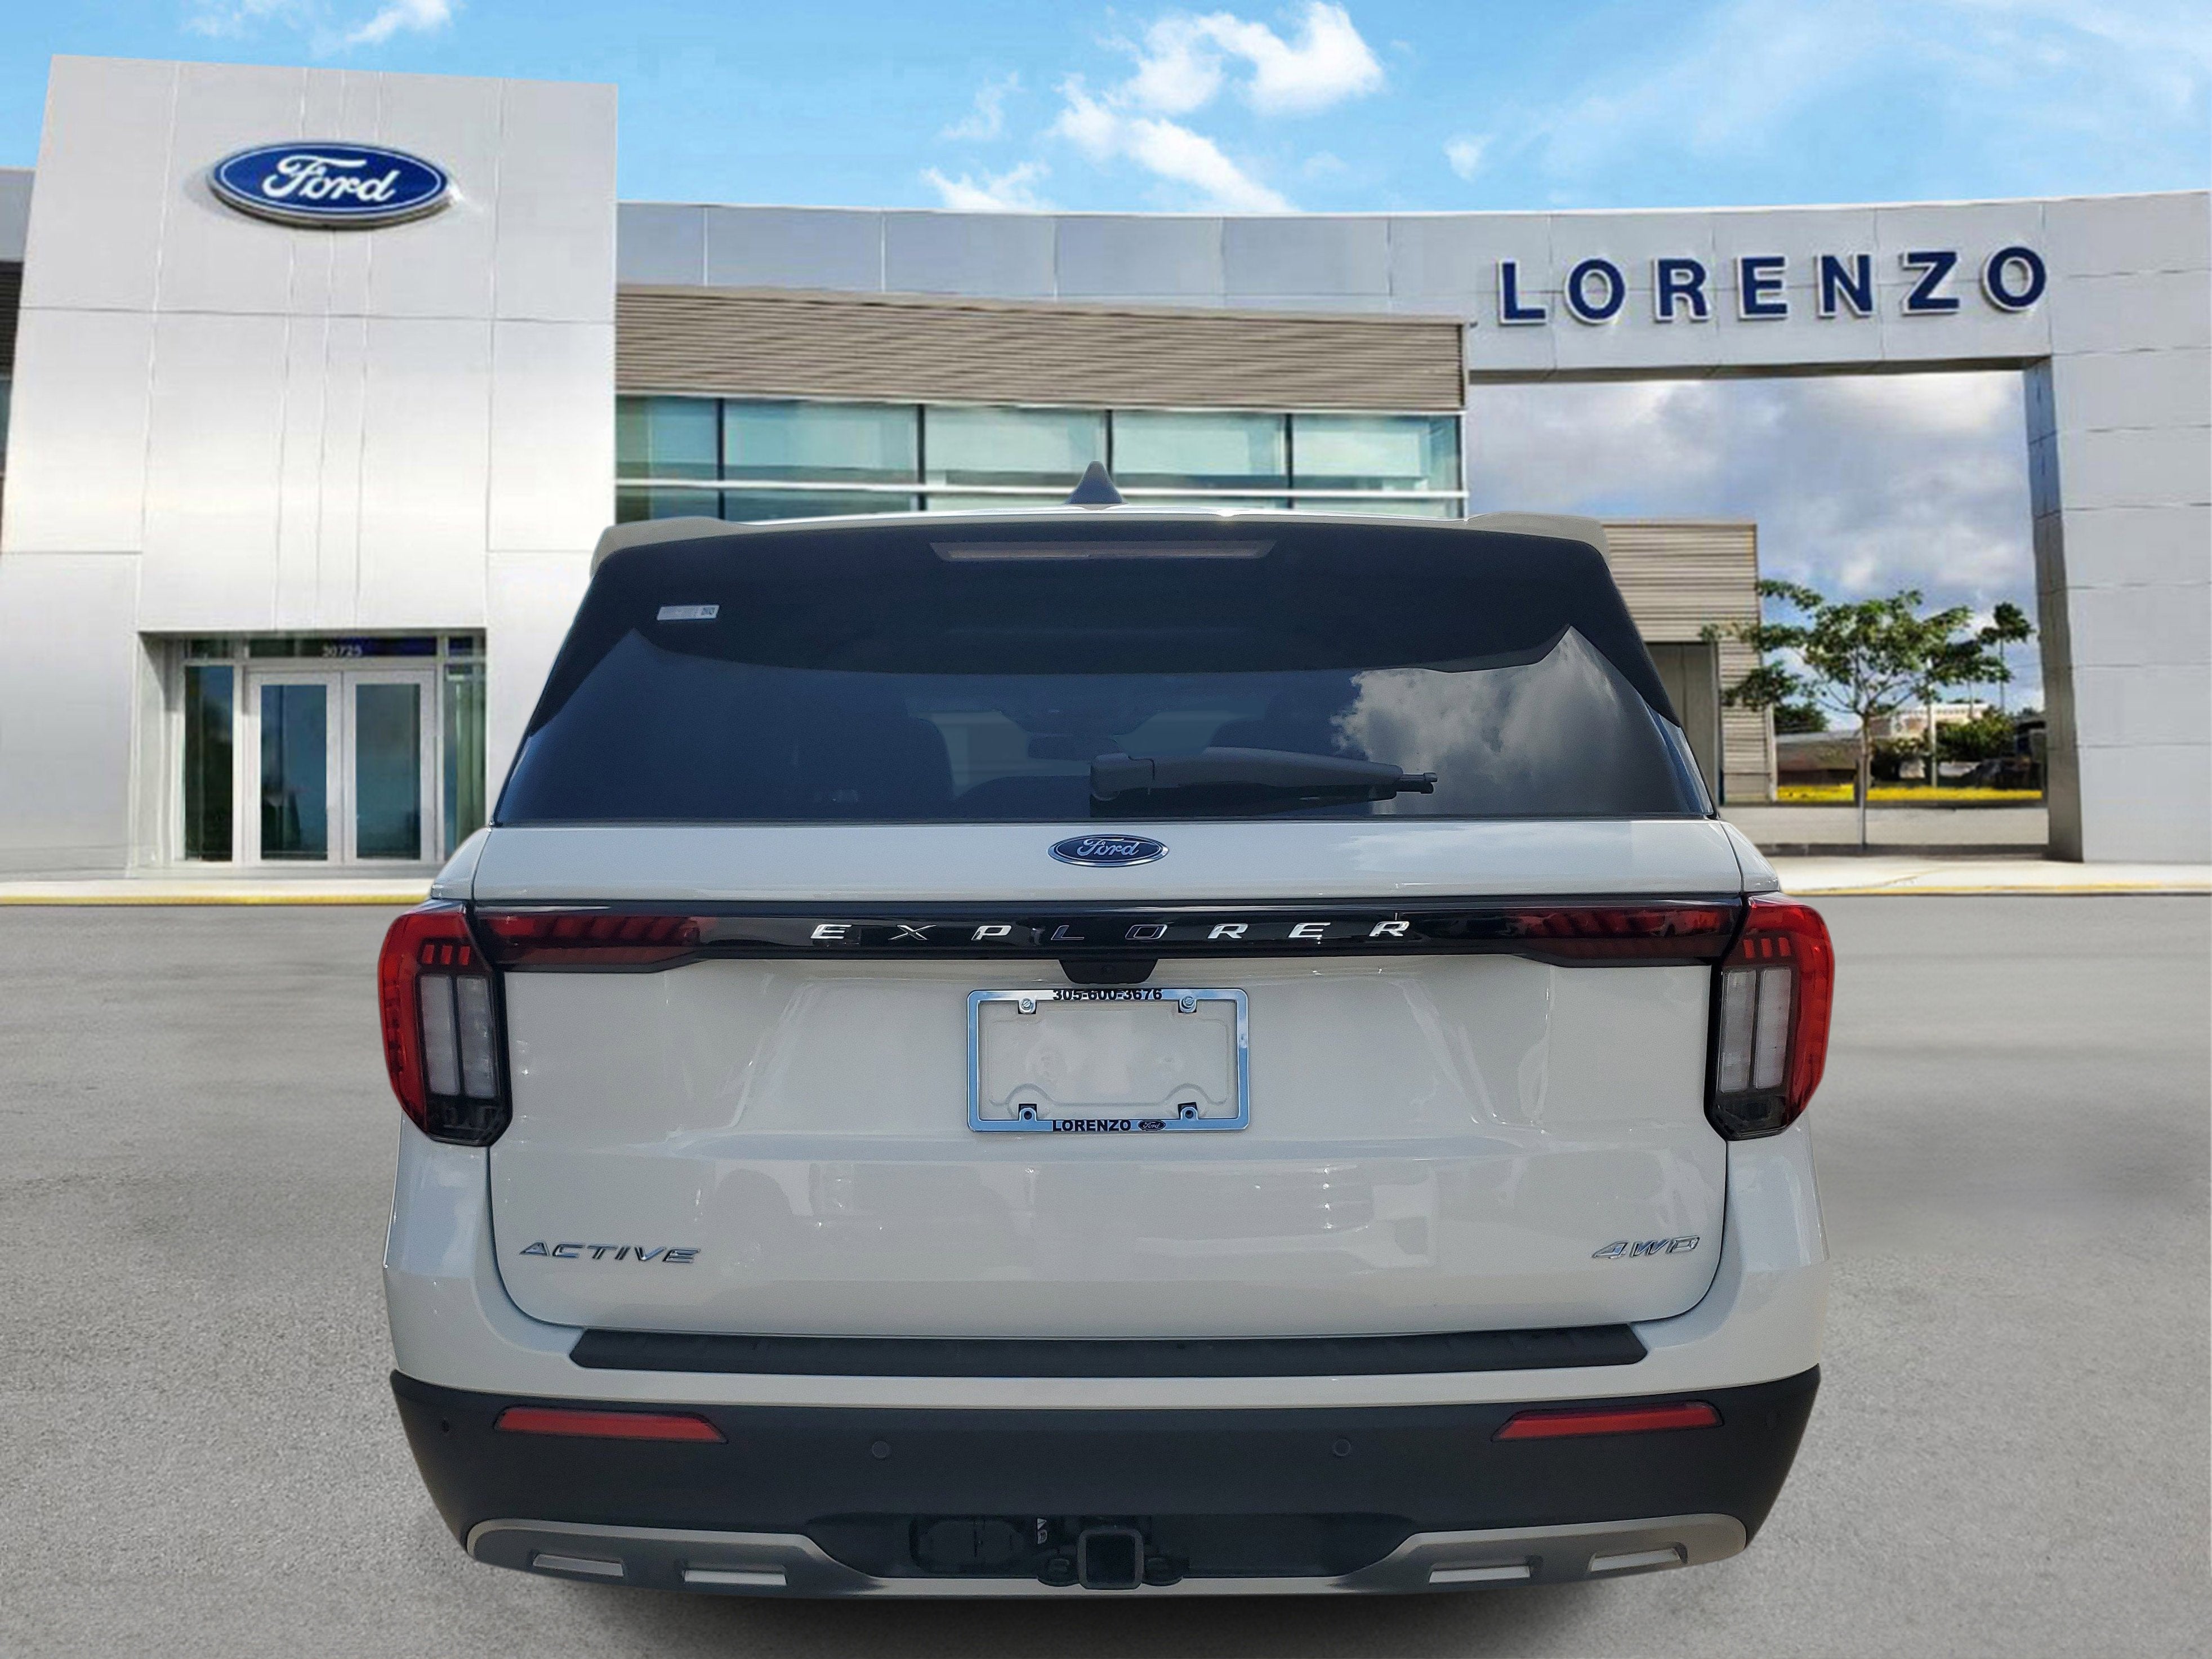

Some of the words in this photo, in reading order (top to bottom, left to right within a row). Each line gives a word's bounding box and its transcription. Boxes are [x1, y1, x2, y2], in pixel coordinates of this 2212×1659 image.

[262, 155, 400, 202] Ford
[1498, 246, 2046, 324] LORENZO
[1077, 838, 1140, 857] Ford
[810, 920, 1411, 942] EXPLORER
[1053, 988, 1162, 1001] 305-600-3676
[1052, 1119, 1132, 1131] LORENZO
[1142, 1121, 1162, 1130] Ford
[520, 1242, 701, 1263] ACTIVE
[1591, 1235, 1700, 1259] 4WD
